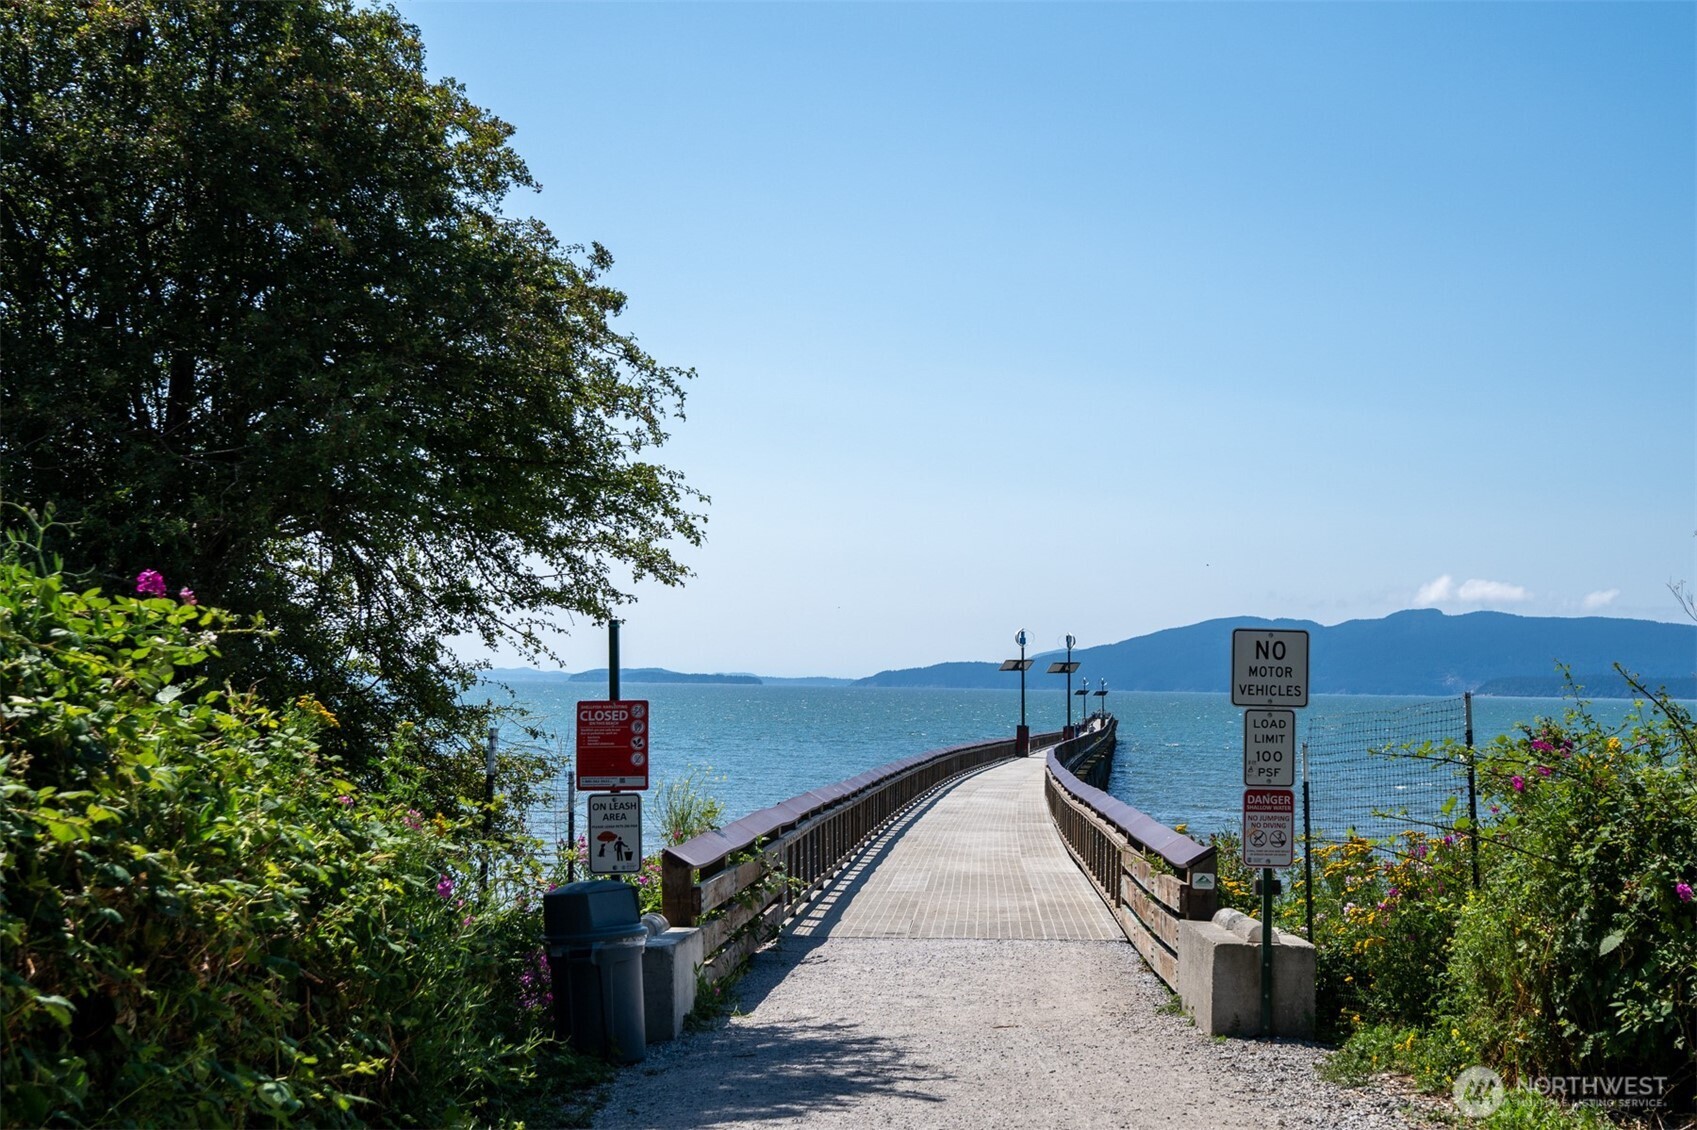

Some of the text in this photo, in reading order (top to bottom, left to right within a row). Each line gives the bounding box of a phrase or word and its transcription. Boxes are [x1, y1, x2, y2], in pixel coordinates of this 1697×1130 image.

[1256, 640, 1286, 660] NO
[1248, 666, 1293, 678] MOTOR
[1239, 684, 1302, 697] VEHICLES
[580, 710, 629, 721] CLOSED
[1253, 719, 1286, 729] LOAD
[1254, 734, 1286, 744] LIMIT
[1256, 750, 1283, 762] 100
[1258, 768, 1281, 777] PSF
[1247, 795, 1291, 805] DANGER
[592, 802, 637, 811] ON LEASH
